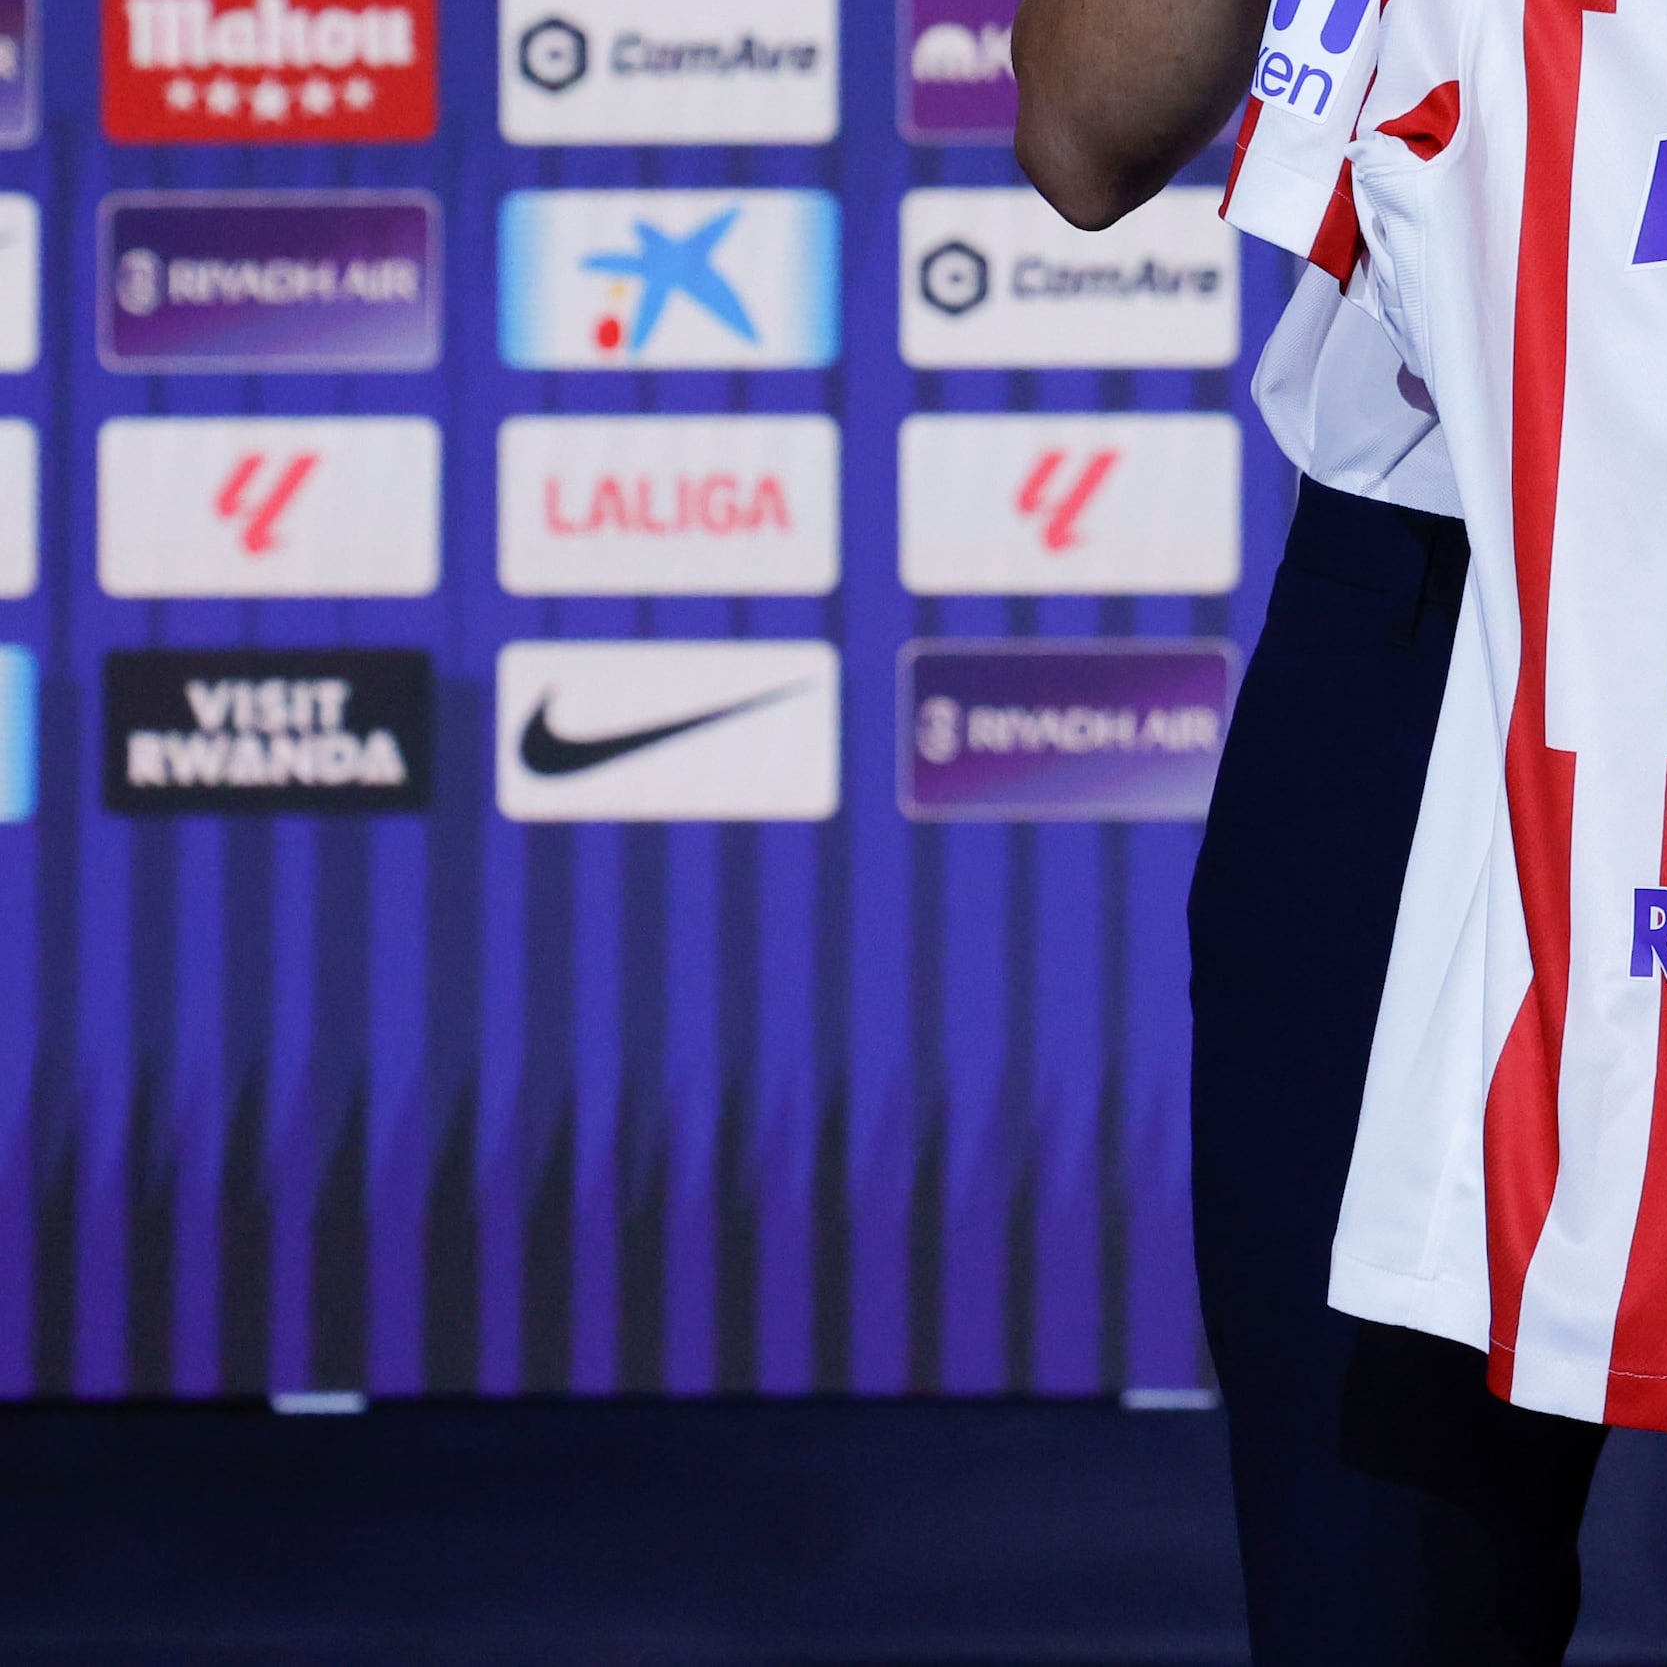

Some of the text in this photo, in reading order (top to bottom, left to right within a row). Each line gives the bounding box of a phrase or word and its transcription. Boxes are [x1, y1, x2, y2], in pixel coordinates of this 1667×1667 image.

[544, 473, 791, 537] LALIGA
[187, 679, 348, 731] VISIT
[128, 731, 405, 785] RWANDA
